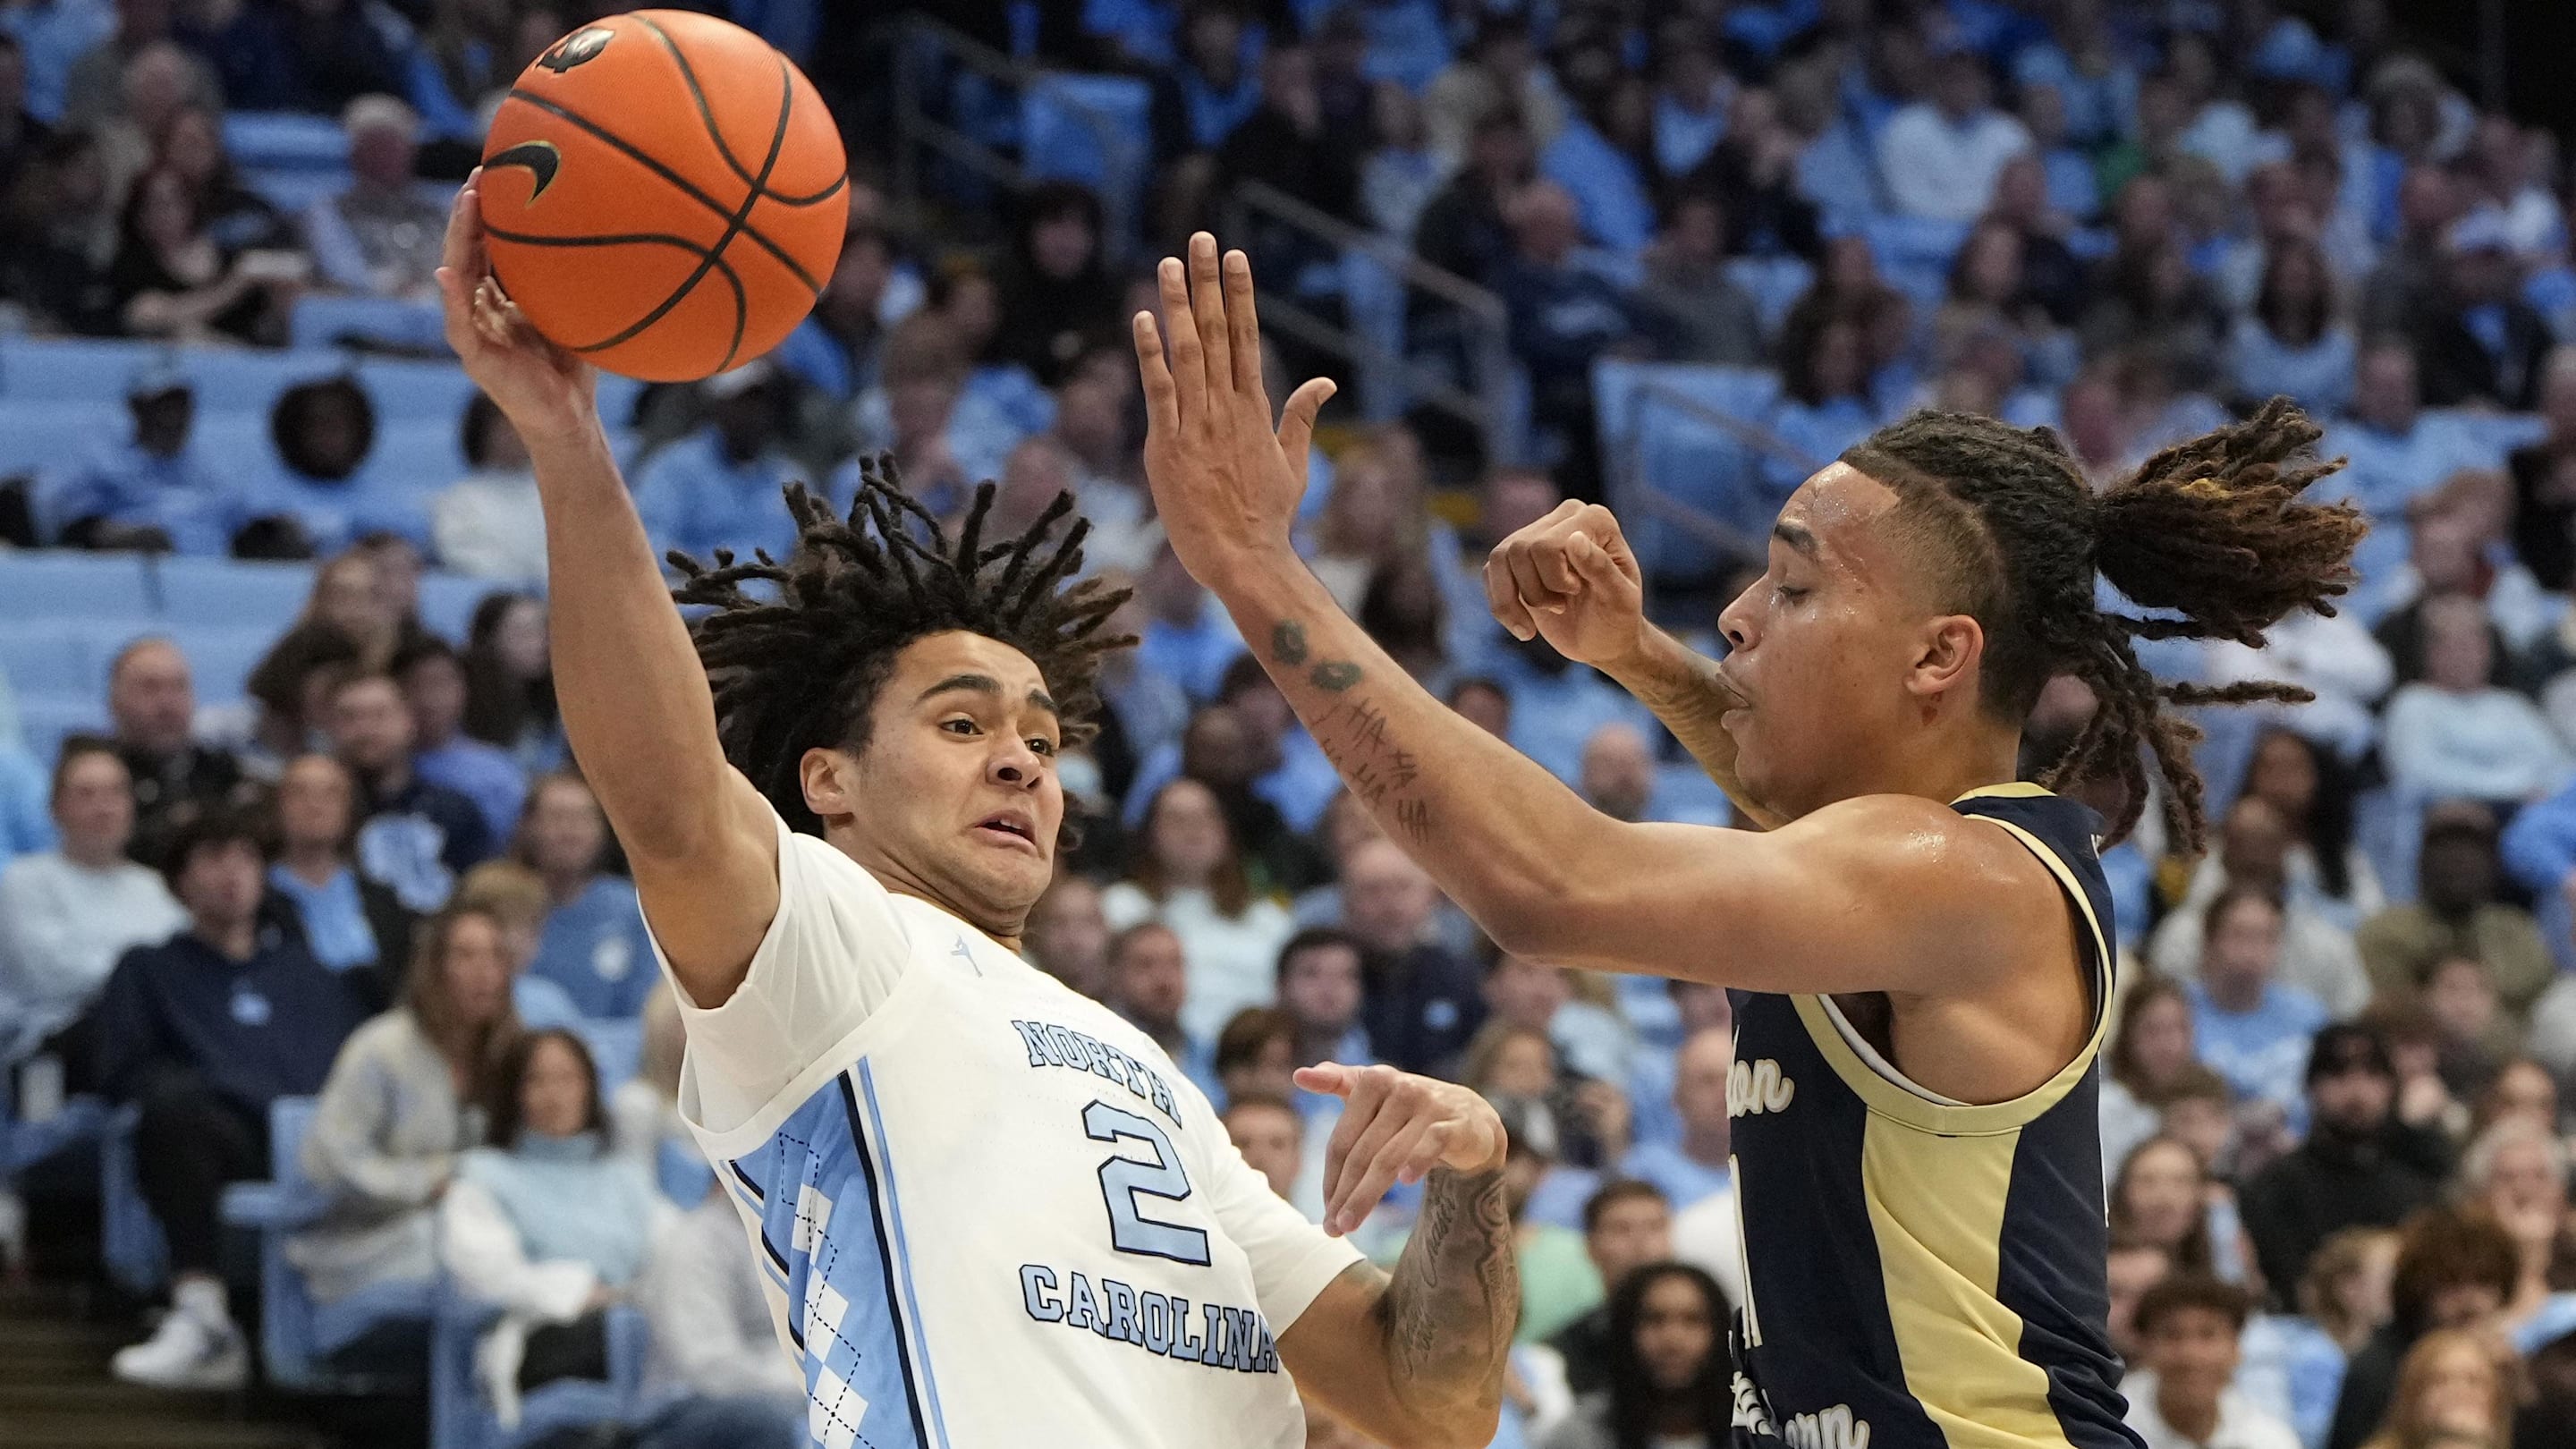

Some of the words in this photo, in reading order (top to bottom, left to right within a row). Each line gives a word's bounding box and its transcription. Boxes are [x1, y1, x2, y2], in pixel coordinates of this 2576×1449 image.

[1011, 1020, 1182, 1130] NORTH
[1080, 1098, 1212, 1267] 2
[1019, 1263, 1278, 1374] CAROLINA
